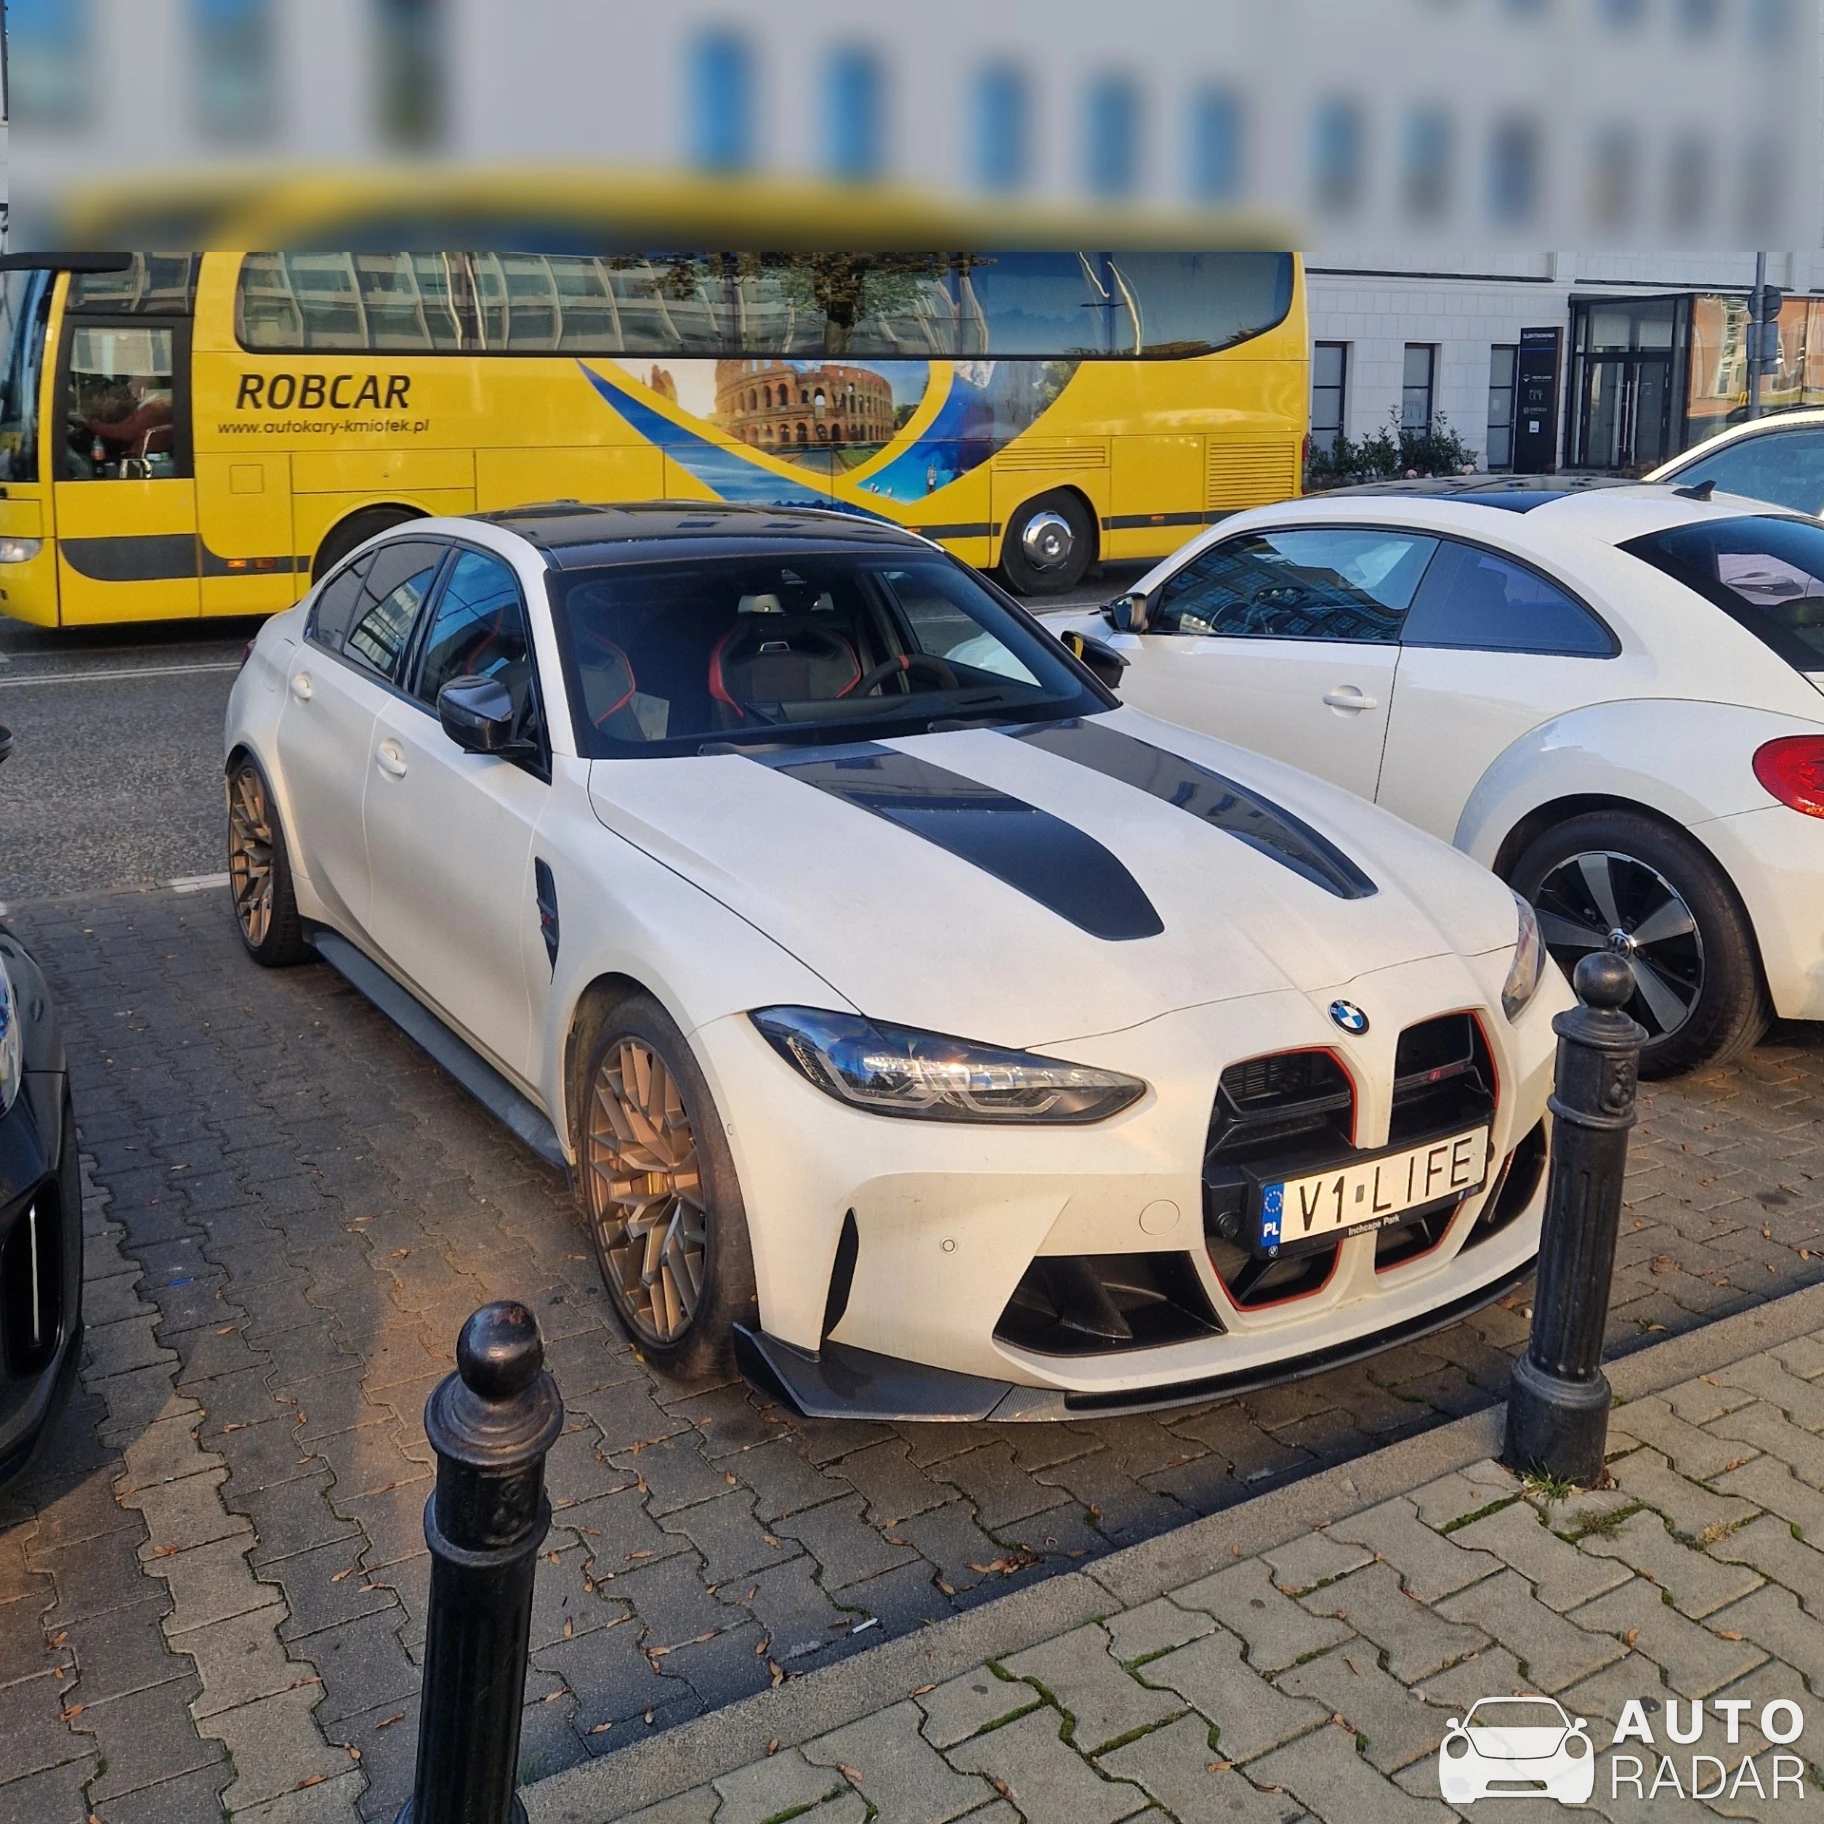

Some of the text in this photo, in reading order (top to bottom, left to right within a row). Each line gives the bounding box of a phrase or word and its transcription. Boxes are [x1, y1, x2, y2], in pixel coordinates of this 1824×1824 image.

[235, 373, 412, 409] ROBCAR
[217, 418, 429, 436] www.autokary-kmiotek.pl
[1299, 1137, 1473, 1231] V1 LIFE
[1263, 1221, 1280, 1238] PL
